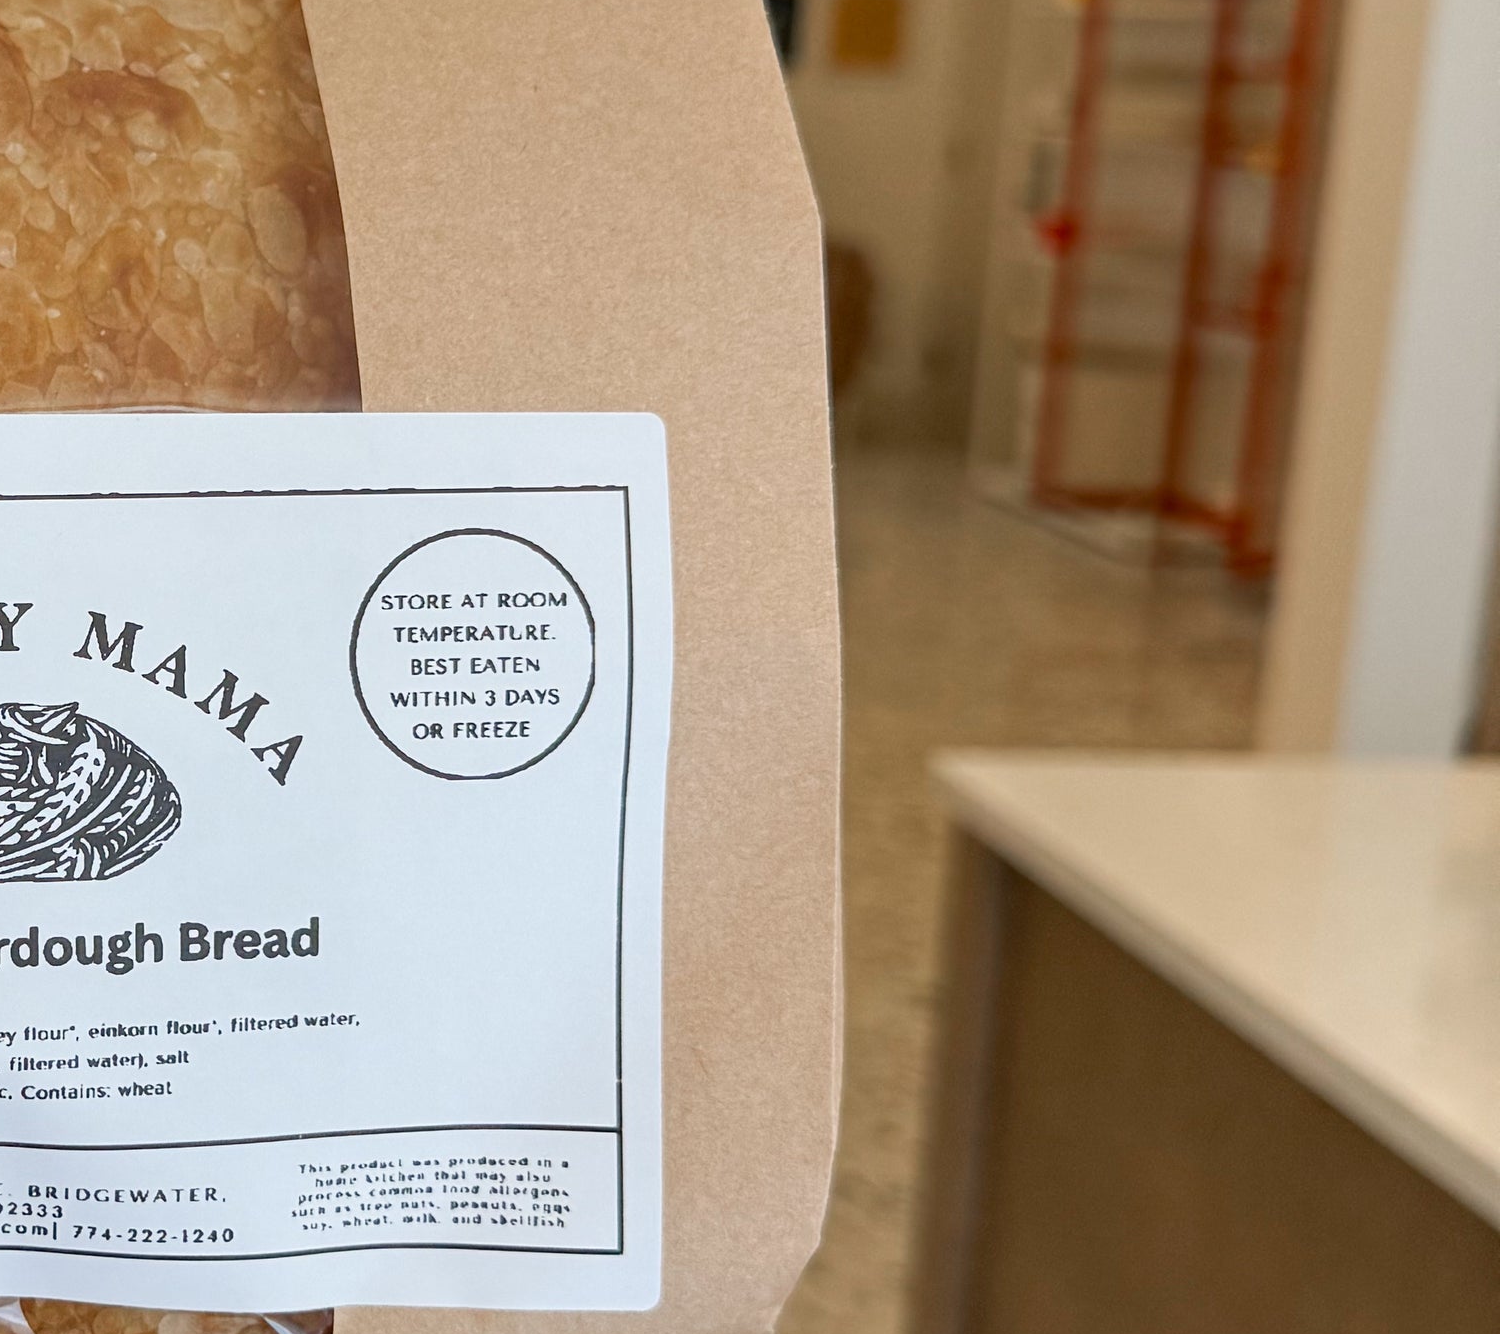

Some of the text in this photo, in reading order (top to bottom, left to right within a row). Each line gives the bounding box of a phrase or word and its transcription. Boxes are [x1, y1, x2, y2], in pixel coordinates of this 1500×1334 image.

[381, 592, 567, 610] STORE AT ROOM
[393, 624, 556, 643] TEMPERATURE.
[411, 657, 540, 675] BEST EATEN
[73, 610, 305, 787] MAMA
[390, 691, 476, 708] WITHIN
[505, 688, 560, 705] DAYS
[412, 721, 530, 739] OR FREEZE
[179, 917, 320, 963] Bread
[88, 1022, 158, 1039] einkorn
[231, 1015, 299, 1033] filtered
[303, 1011, 360, 1028] water,
[9, 1055, 79, 1072] filtered
[155, 1050, 190, 1065] salt
[21, 1083, 112, 1100] Contains:
[117, 1081, 173, 1098] wheat
[299, 1164, 331, 1174] This
[340, 1158, 402, 1174] product
[449, 1156, 529, 1168] produced
[537, 1159, 552, 1168] in
[28, 1185, 226, 1203] BRIDGEWATER,
[72, 1224, 234, 1244] 774-222-1240
